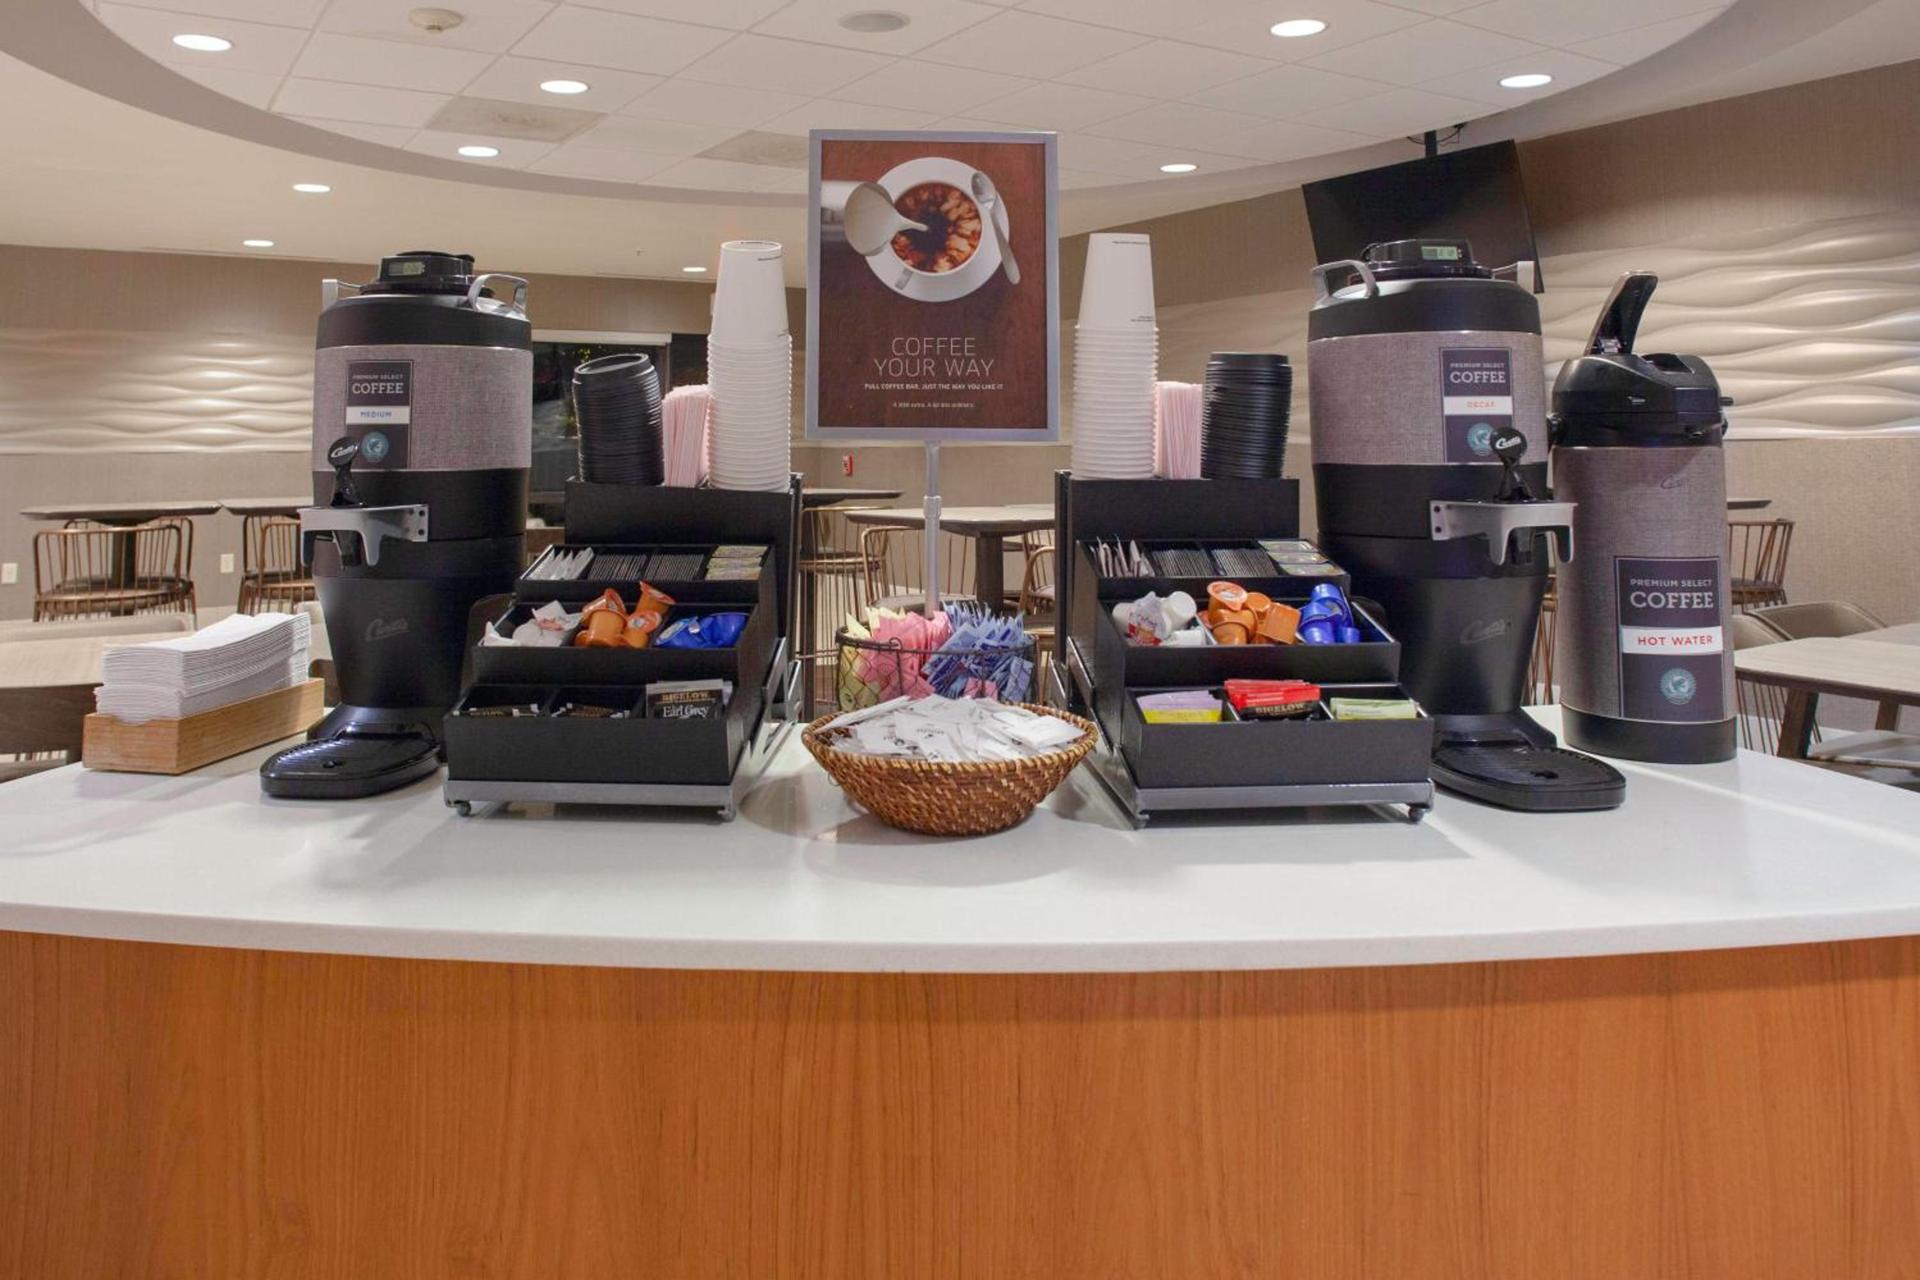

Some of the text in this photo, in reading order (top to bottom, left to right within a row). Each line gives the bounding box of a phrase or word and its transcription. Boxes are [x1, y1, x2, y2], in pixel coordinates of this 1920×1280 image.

[891, 337, 976, 356] COFFEE
[873, 358, 995, 377] YOUR WAY
[1449, 371, 1506, 383] COFFEE
[352, 382, 404, 394] COFFEE
[1629, 579, 1712, 587] PREMIUM SELECT
[1629, 591, 1714, 609] COFFEE
[1637, 635, 1713, 646] HOT WATER
[662, 704, 684, 718] Earl
[1255, 703, 1306, 714] BIGELOW
